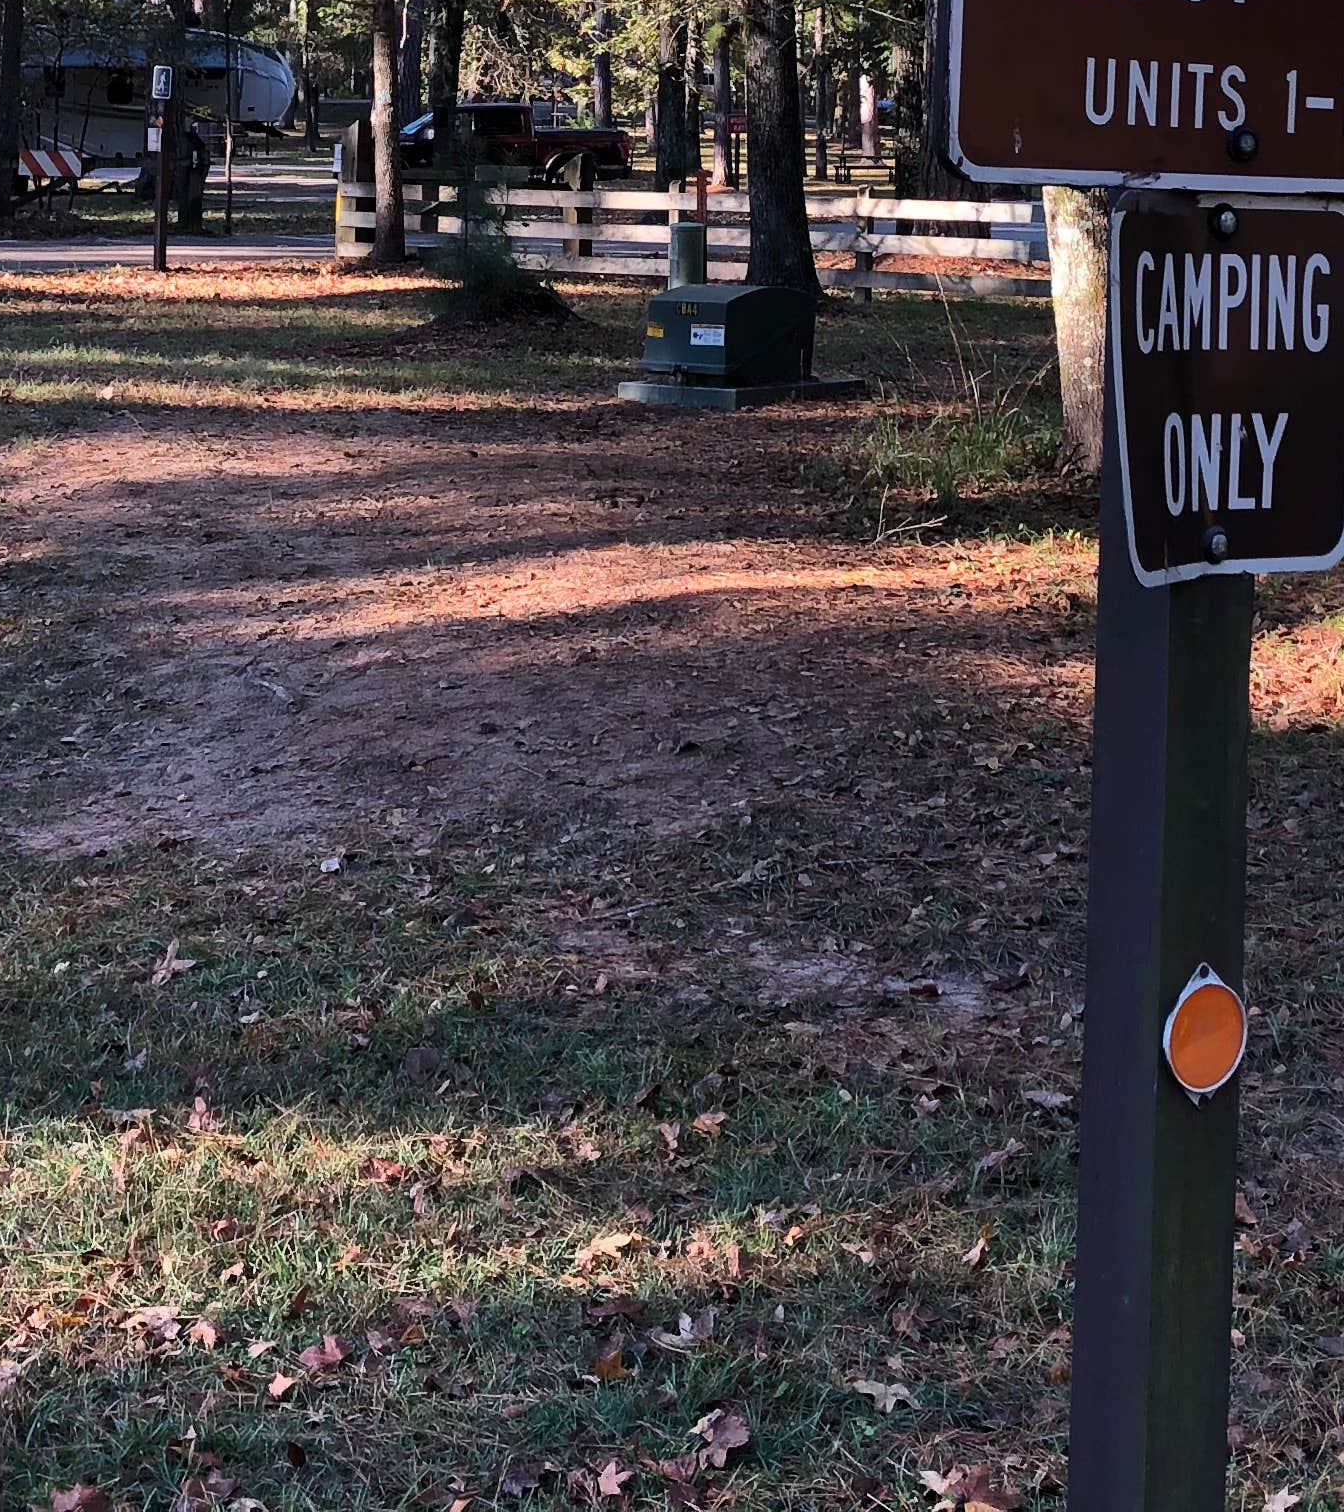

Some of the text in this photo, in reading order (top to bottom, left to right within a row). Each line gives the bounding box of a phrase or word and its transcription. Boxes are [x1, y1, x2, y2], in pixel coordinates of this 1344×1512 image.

[1084, 56, 1247, 132] UNITS
[1135, 250, 1332, 355] CAMPING
[1163, 411, 1290, 517] ONLY
